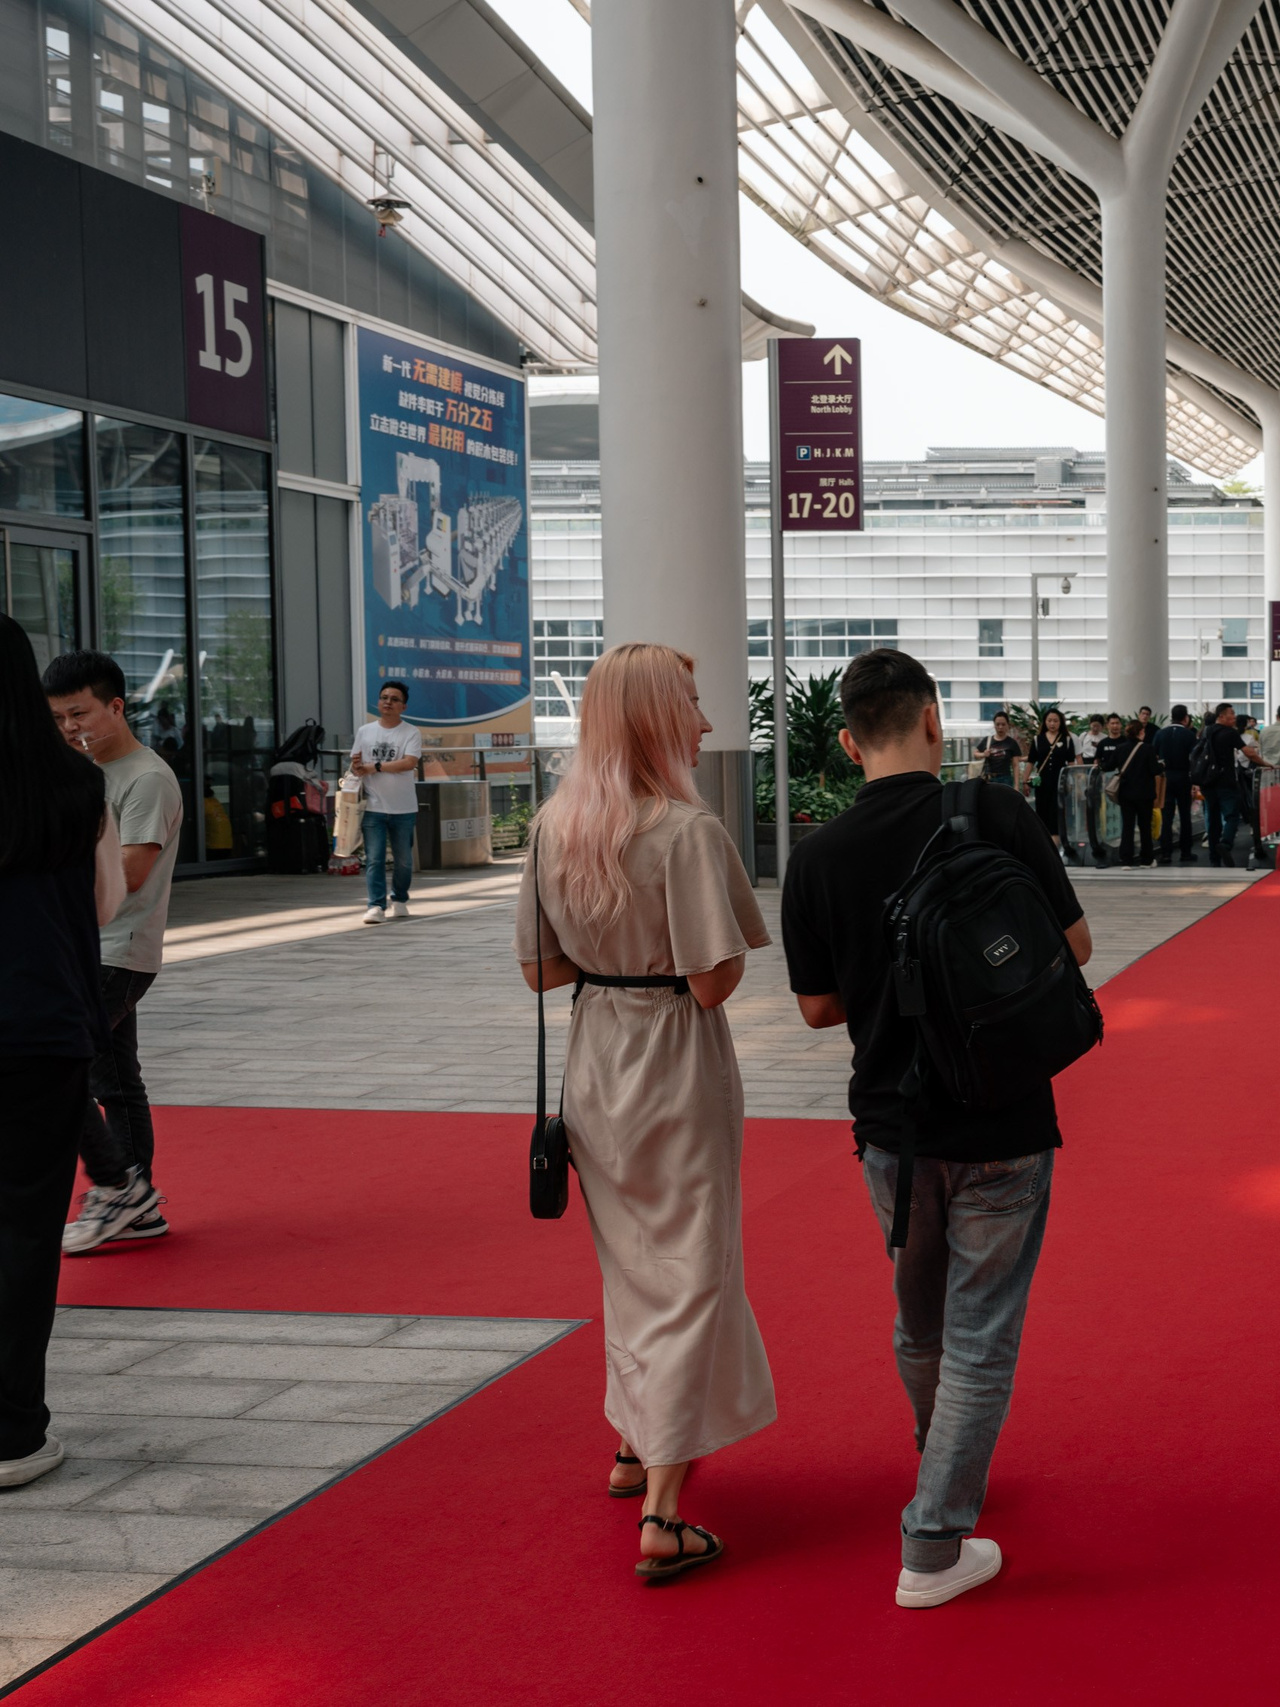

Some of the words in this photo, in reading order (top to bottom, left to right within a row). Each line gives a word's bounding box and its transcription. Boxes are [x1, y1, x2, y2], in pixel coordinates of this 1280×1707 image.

[195, 273, 253, 378] 15
[382, 354, 412, 379] 新一代
[412, 358, 463, 395] 无需建模
[811, 394, 853, 404] 北登录大厅
[811, 405, 831, 414] North
[832, 405, 853, 415] Lobby
[445, 398, 493, 432] 万分之五
[428, 422, 465, 453] 最好用
[839, 478, 855, 486] Halls
[788, 492, 855, 519] 17-20
[372, 749, 396, 758] NVG
